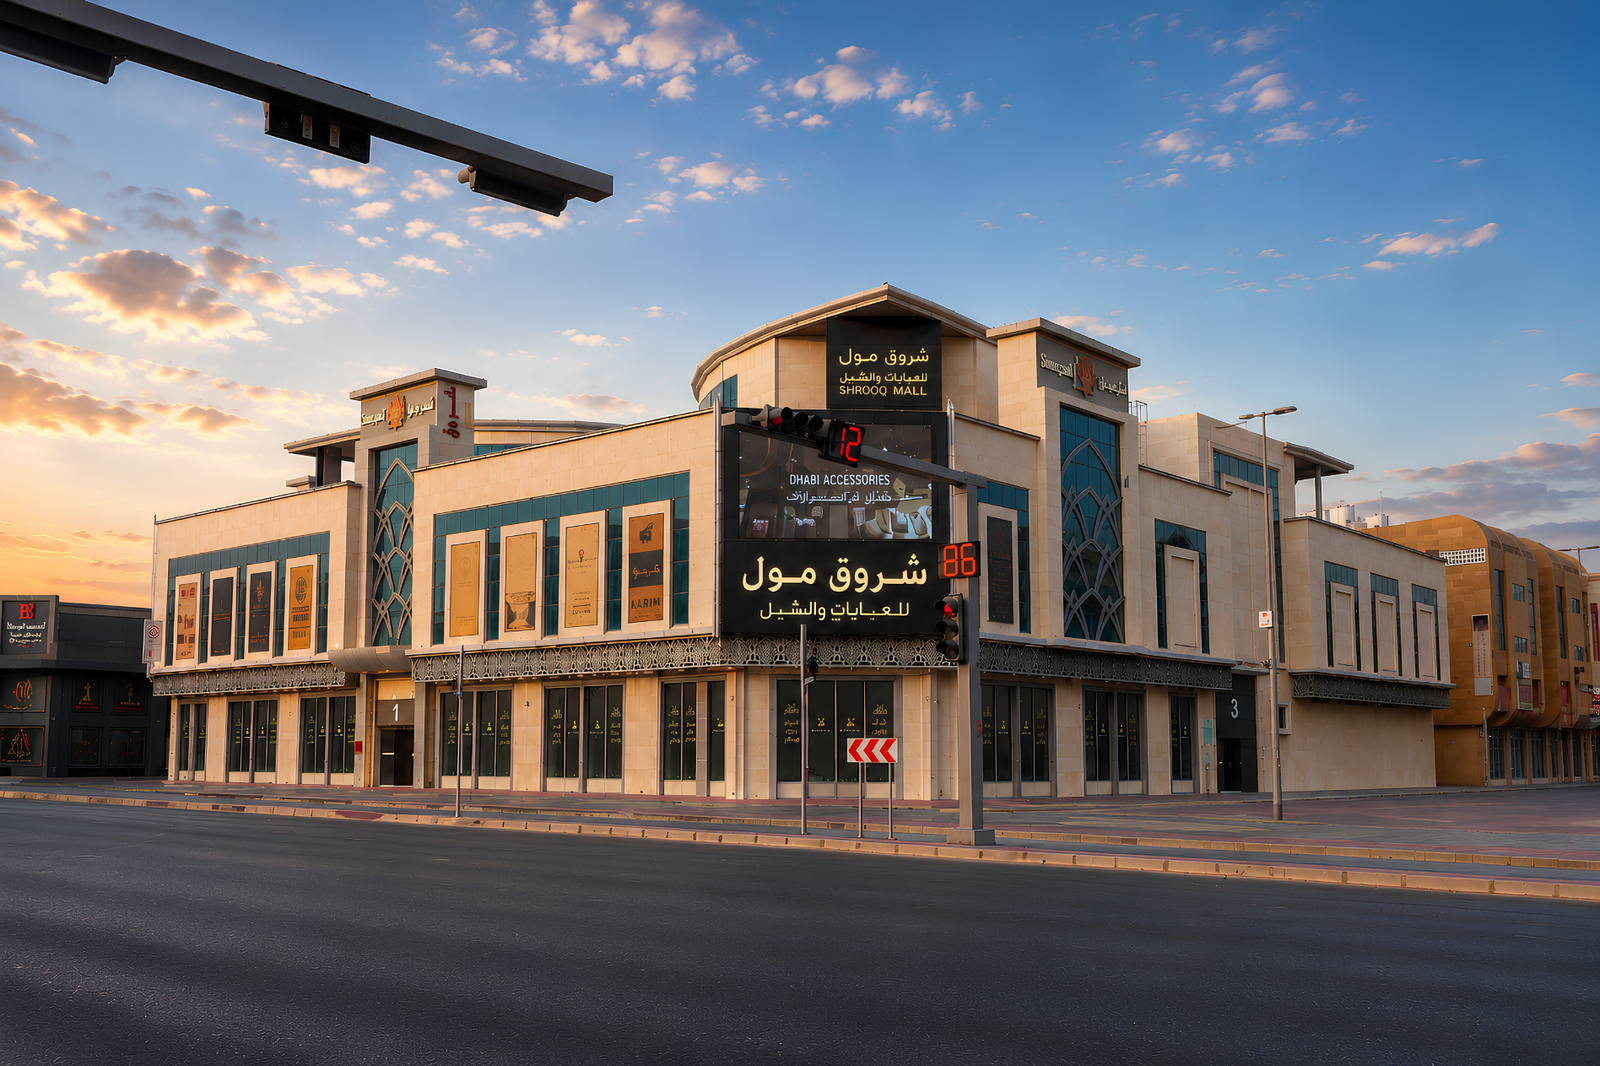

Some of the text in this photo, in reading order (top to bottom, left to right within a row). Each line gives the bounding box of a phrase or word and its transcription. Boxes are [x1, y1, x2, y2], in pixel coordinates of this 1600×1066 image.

[839, 348, 929, 366] شروق مول
[839, 372, 928, 385] للعبايات والشيل
[839, 385, 927, 397] SHROOQ MALL
[789, 474, 890, 486] DHABI ACCESSORIES
[943, 542, 976, 577] 86
[742, 553, 928, 593] شروق مول
[760, 599, 910, 621] للعبايات والشيل
[392, 703, 398, 722] 1
[1231, 698, 1238, 719] 3
